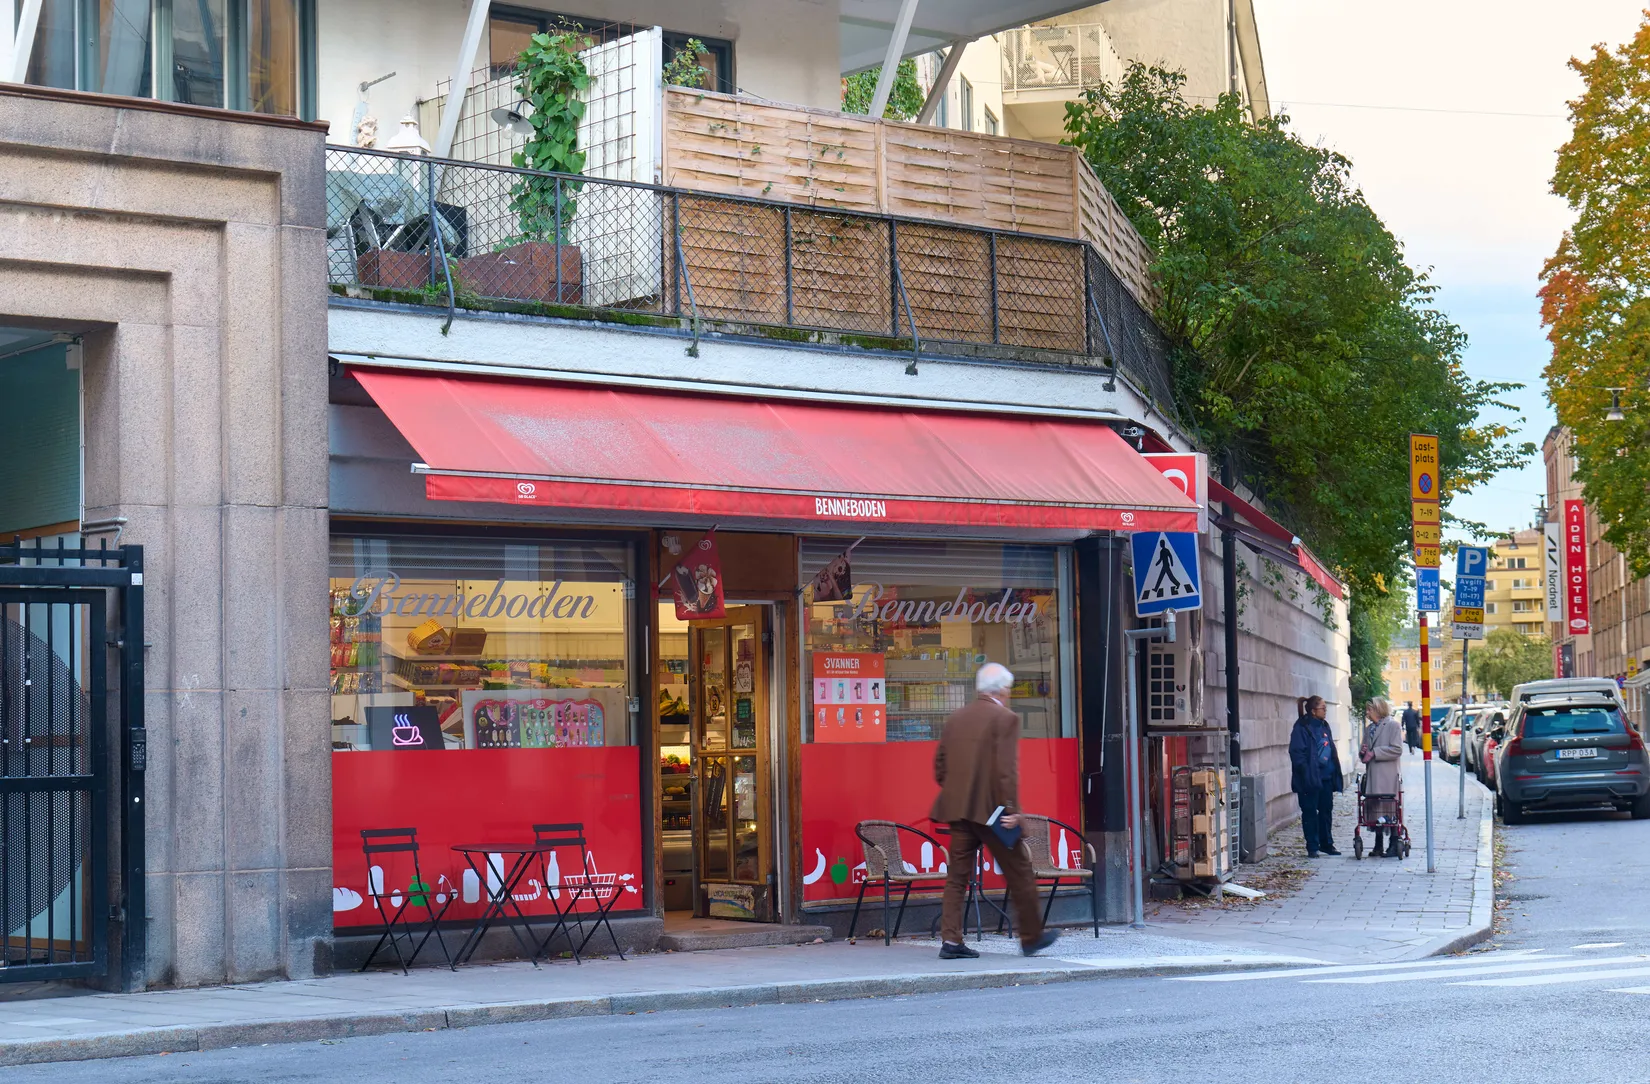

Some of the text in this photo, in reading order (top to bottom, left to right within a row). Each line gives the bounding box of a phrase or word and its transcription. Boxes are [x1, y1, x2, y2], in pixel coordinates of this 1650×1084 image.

[1414, 441, 1435, 452] Last-
[1415, 453, 1435, 465] plats
[815, 497, 887, 517] BENNEBODEN
[1419, 508, 1433, 517] 7-19
[1415, 530, 1430, 539] 0-12
[1570, 504, 1581, 553] AIDEN
[1424, 547, 1437, 556] Fred
[1464, 549, 1482, 574] P
[1459, 578, 1482, 586] Avgift
[341, 570, 599, 619] Benneboden
[1548, 569, 1558, 609] Nordnet
[1571, 565, 1583, 614] HOTEL
[837, 580, 1041, 624] Benneboden
[1455, 623, 1480, 632] Boende
[1562, 749, 1577, 757] RPP
